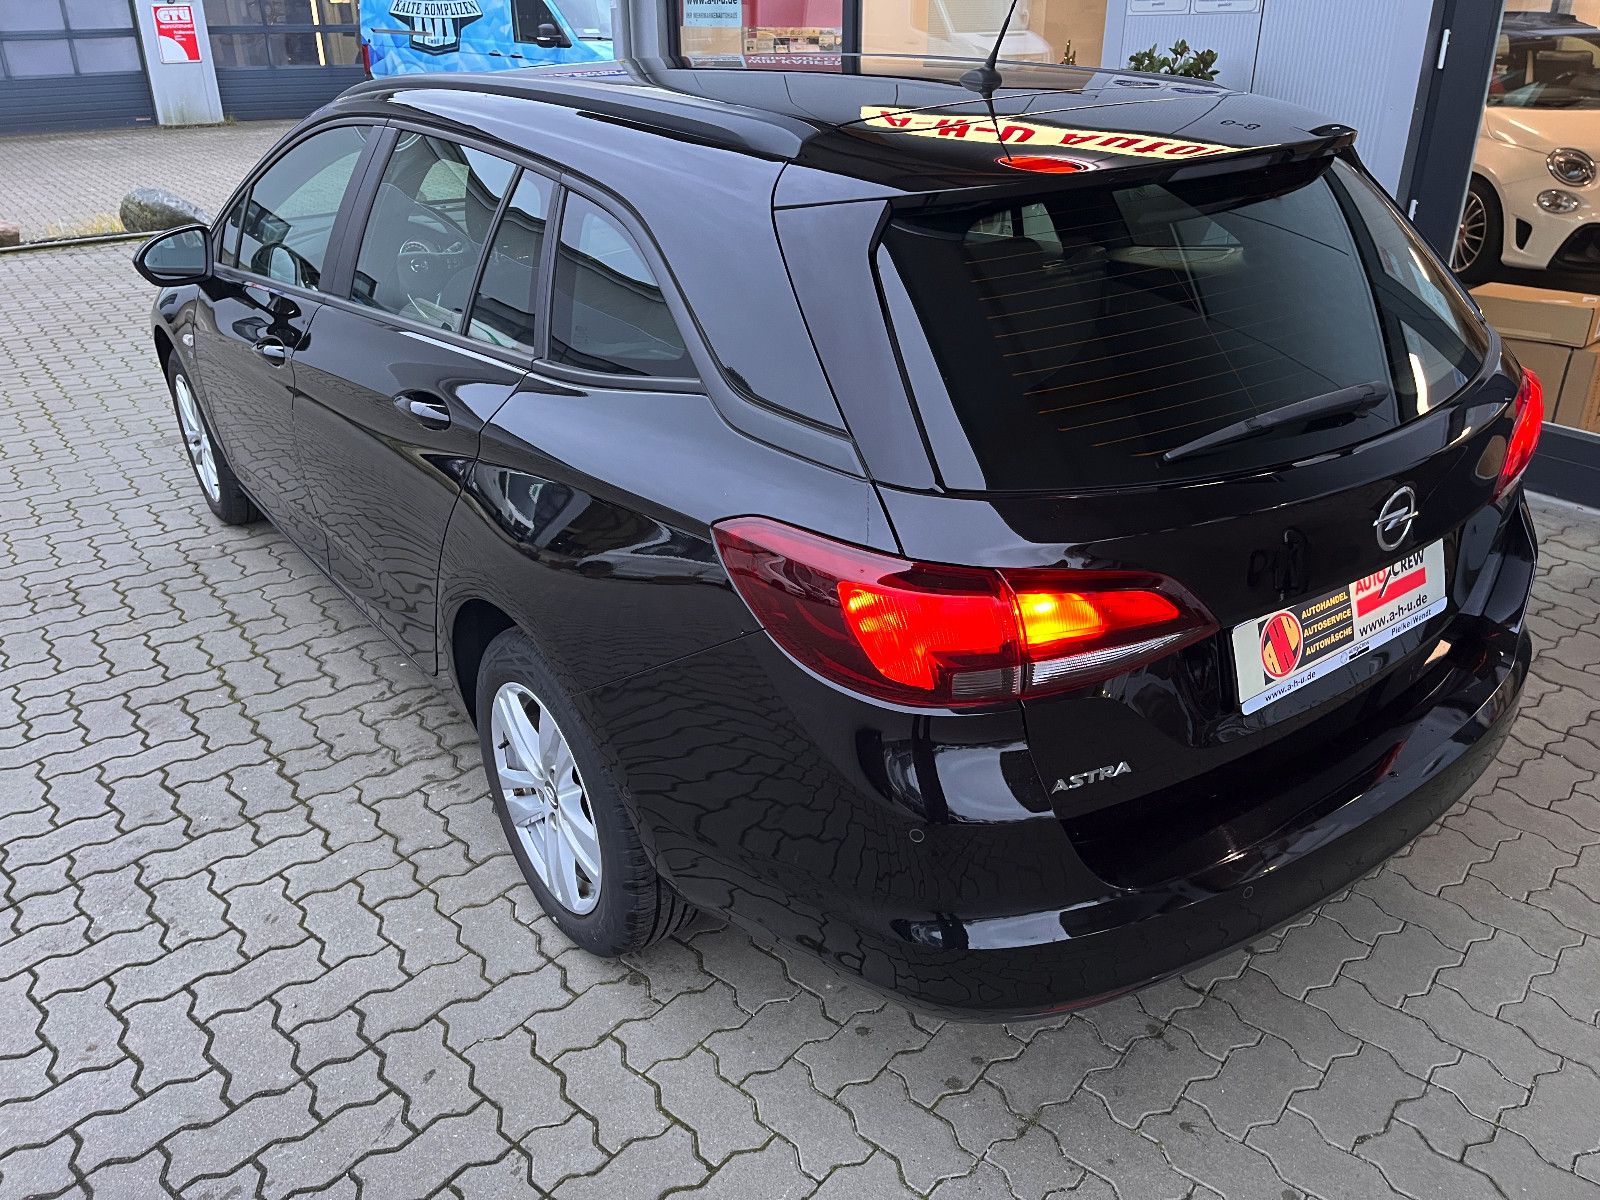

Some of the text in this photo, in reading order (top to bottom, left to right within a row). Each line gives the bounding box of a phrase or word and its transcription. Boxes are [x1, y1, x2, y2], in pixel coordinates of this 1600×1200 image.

[424, 1, 479, 16] KOMPLIZEN
[1301, 592, 1349, 620] AUTOHANDEL
[1359, 594, 1428, 637] www.a-h-u.de
[1303, 608, 1352, 638] AUTOSERVICE
[1265, 671, 1316, 702] www.a-h-u.de
[1051, 761, 1132, 795] ASTRA
